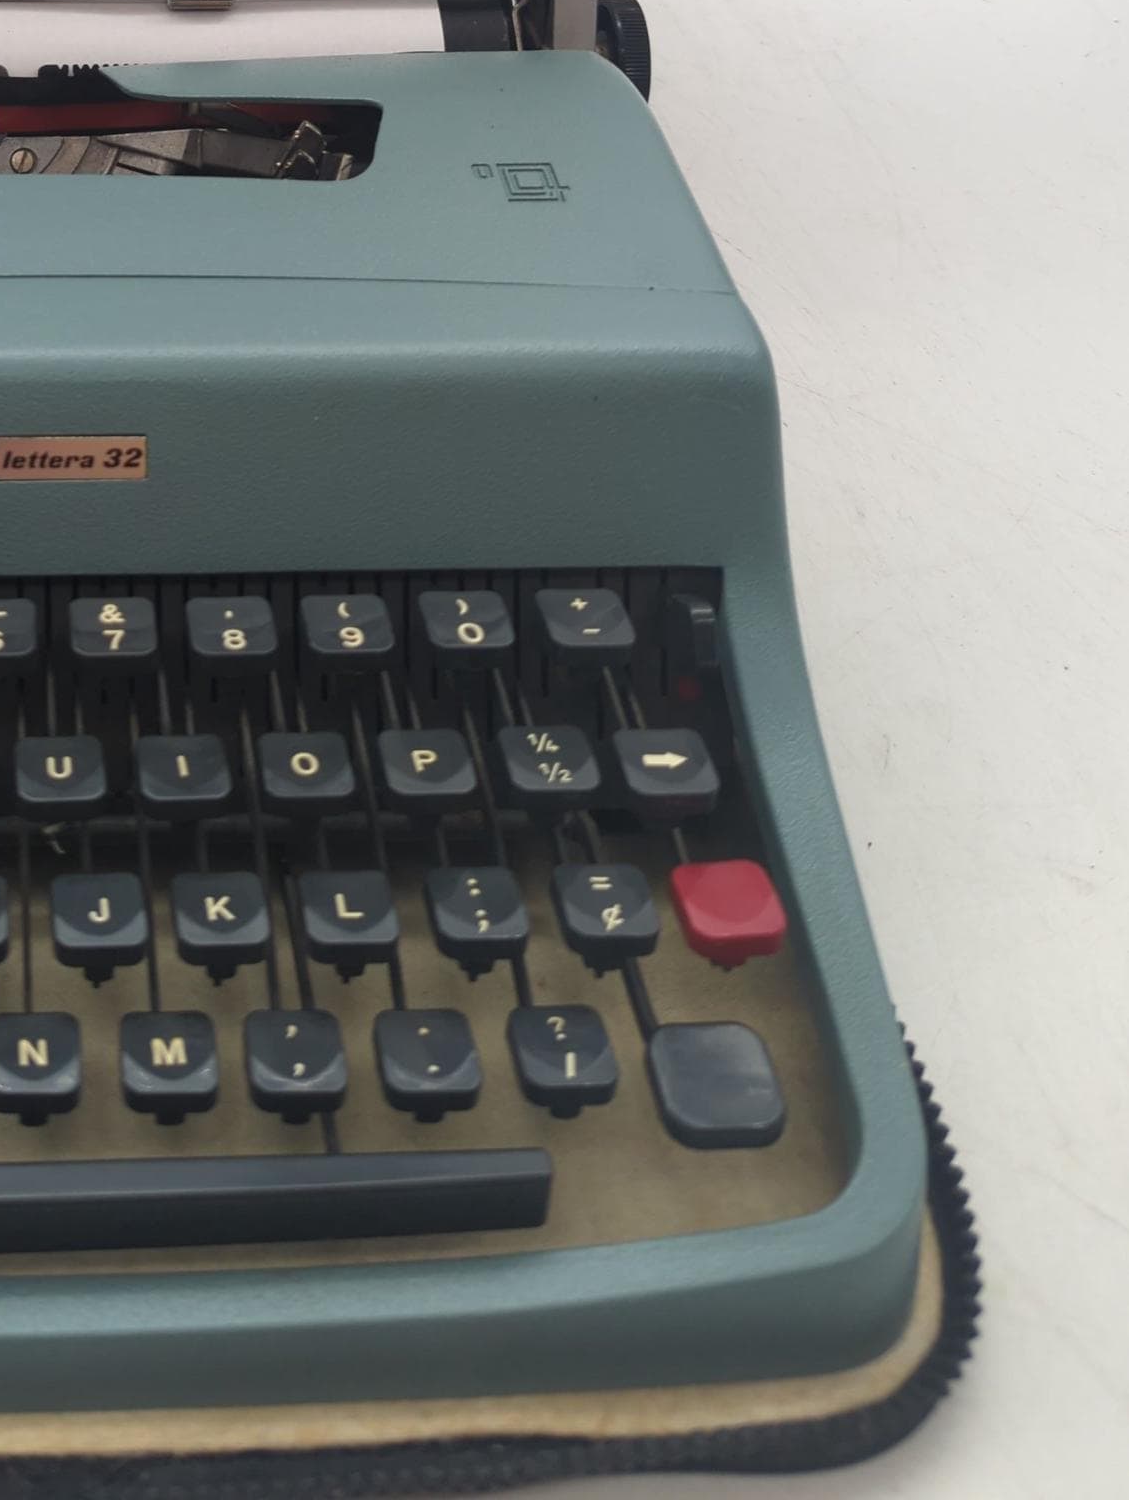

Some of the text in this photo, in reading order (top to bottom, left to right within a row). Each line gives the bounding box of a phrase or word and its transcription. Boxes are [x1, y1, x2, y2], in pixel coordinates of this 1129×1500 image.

[2, 449, 95, 471] lettera
[102, 447, 144, 469] 32
[98, 603, 126, 625] &
[337, 602, 351, 619] (
[457, 599, 470, 615] )
[570, 597, 588, 611] +
[102, 629, 126, 651] 7
[222, 628, 247, 650] 8
[338, 626, 364, 648] 9
[456, 622, 485, 645] 0
[46, 756, 73, 779] U
[176, 755, 189, 777] I
[290, 752, 319, 775] O
[411, 749, 437, 772] P
[466, 877, 481, 896] :
[589, 875, 612, 891] =
[87, 897, 111, 924] J
[205, 895, 235, 921] K
[334, 892, 364, 919] L
[475, 909, 490, 933] ;
[546, 1015, 567, 1041] ?
[17, 1039, 49, 1067] N
[150, 1037, 188, 1066] M
